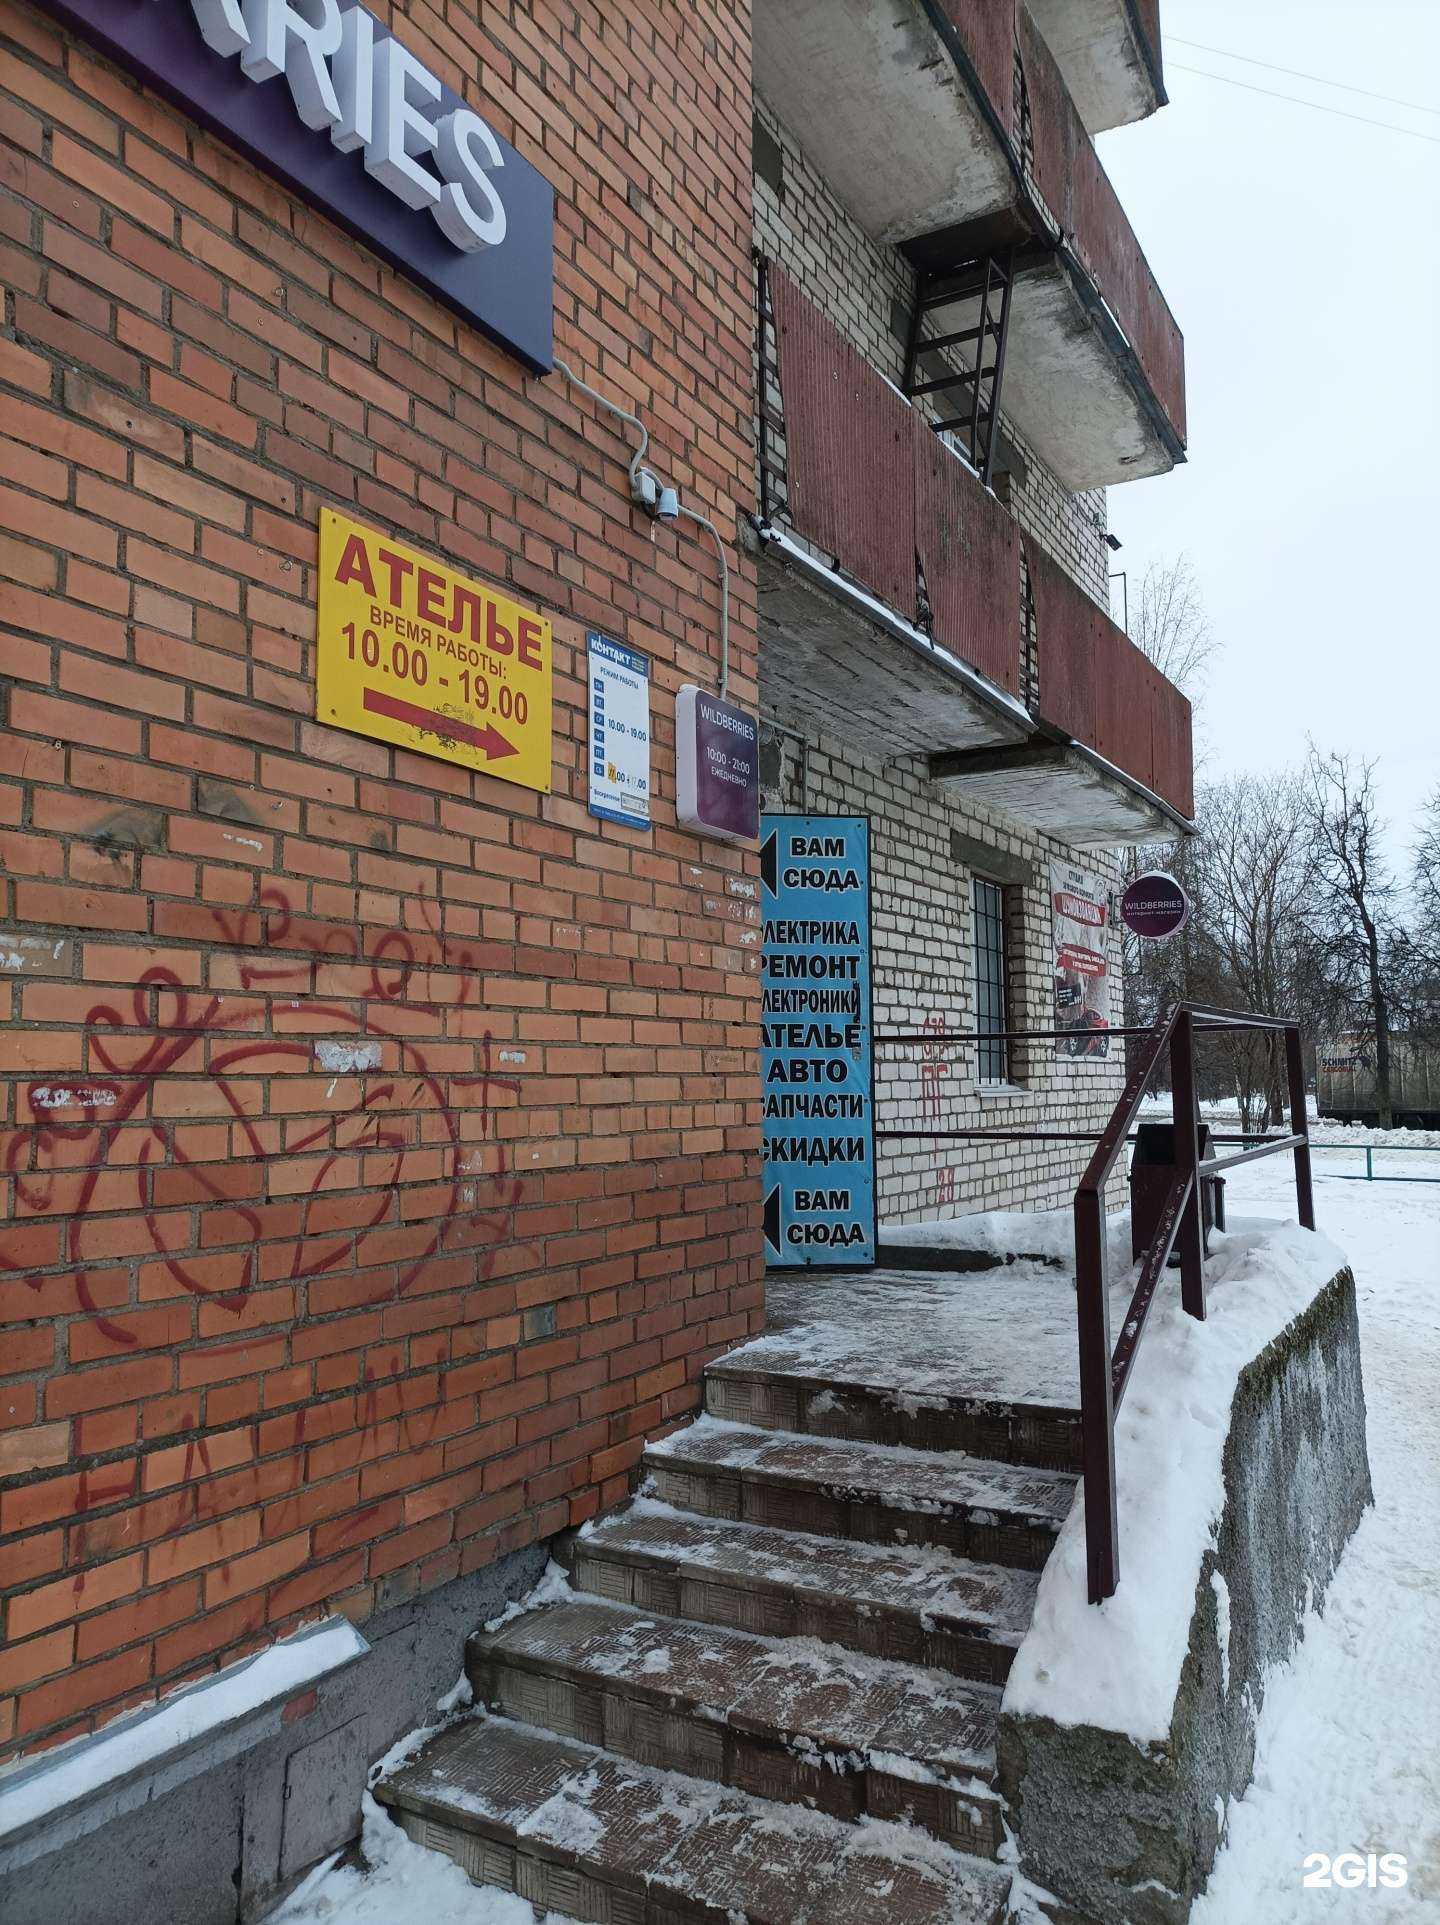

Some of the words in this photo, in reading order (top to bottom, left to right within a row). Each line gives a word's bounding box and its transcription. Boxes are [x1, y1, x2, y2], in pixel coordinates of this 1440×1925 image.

[334, 534, 543, 672] АТЕЛЬЕ
[370, 605, 432, 648] ВРЕМЯ
[437, 634, 507, 680] РАБОТЫ:
[591, 635, 631, 665] КОНТАКТ
[342, 622, 428, 687] 10.00
[458, 669, 528, 726] 19.00
[608, 718, 626, 734] 10.00
[631, 727, 647, 742] 19.00
[700, 703, 755, 741] WILDBERRIES
[706, 746, 727, 765] 10:00
[711, 765, 747, 788] ЕЖЕДНЕВНО
[790, 837, 845, 857] ВАМ
[783, 868, 860, 892] СЮДА
[1124, 900, 1182, 910] WILDBERRIES
[762, 920, 860, 945] ЛЕКТРИКА
[762, 988, 859, 1014] ЛЕКТРОНИКИ
[767, 1058, 848, 1083] АВТО
[762, 1094, 863, 1118] АПЧАСТИ
[794, 1190, 850, 1211] ВАМ
[787, 1223, 865, 1248] СЮДА
